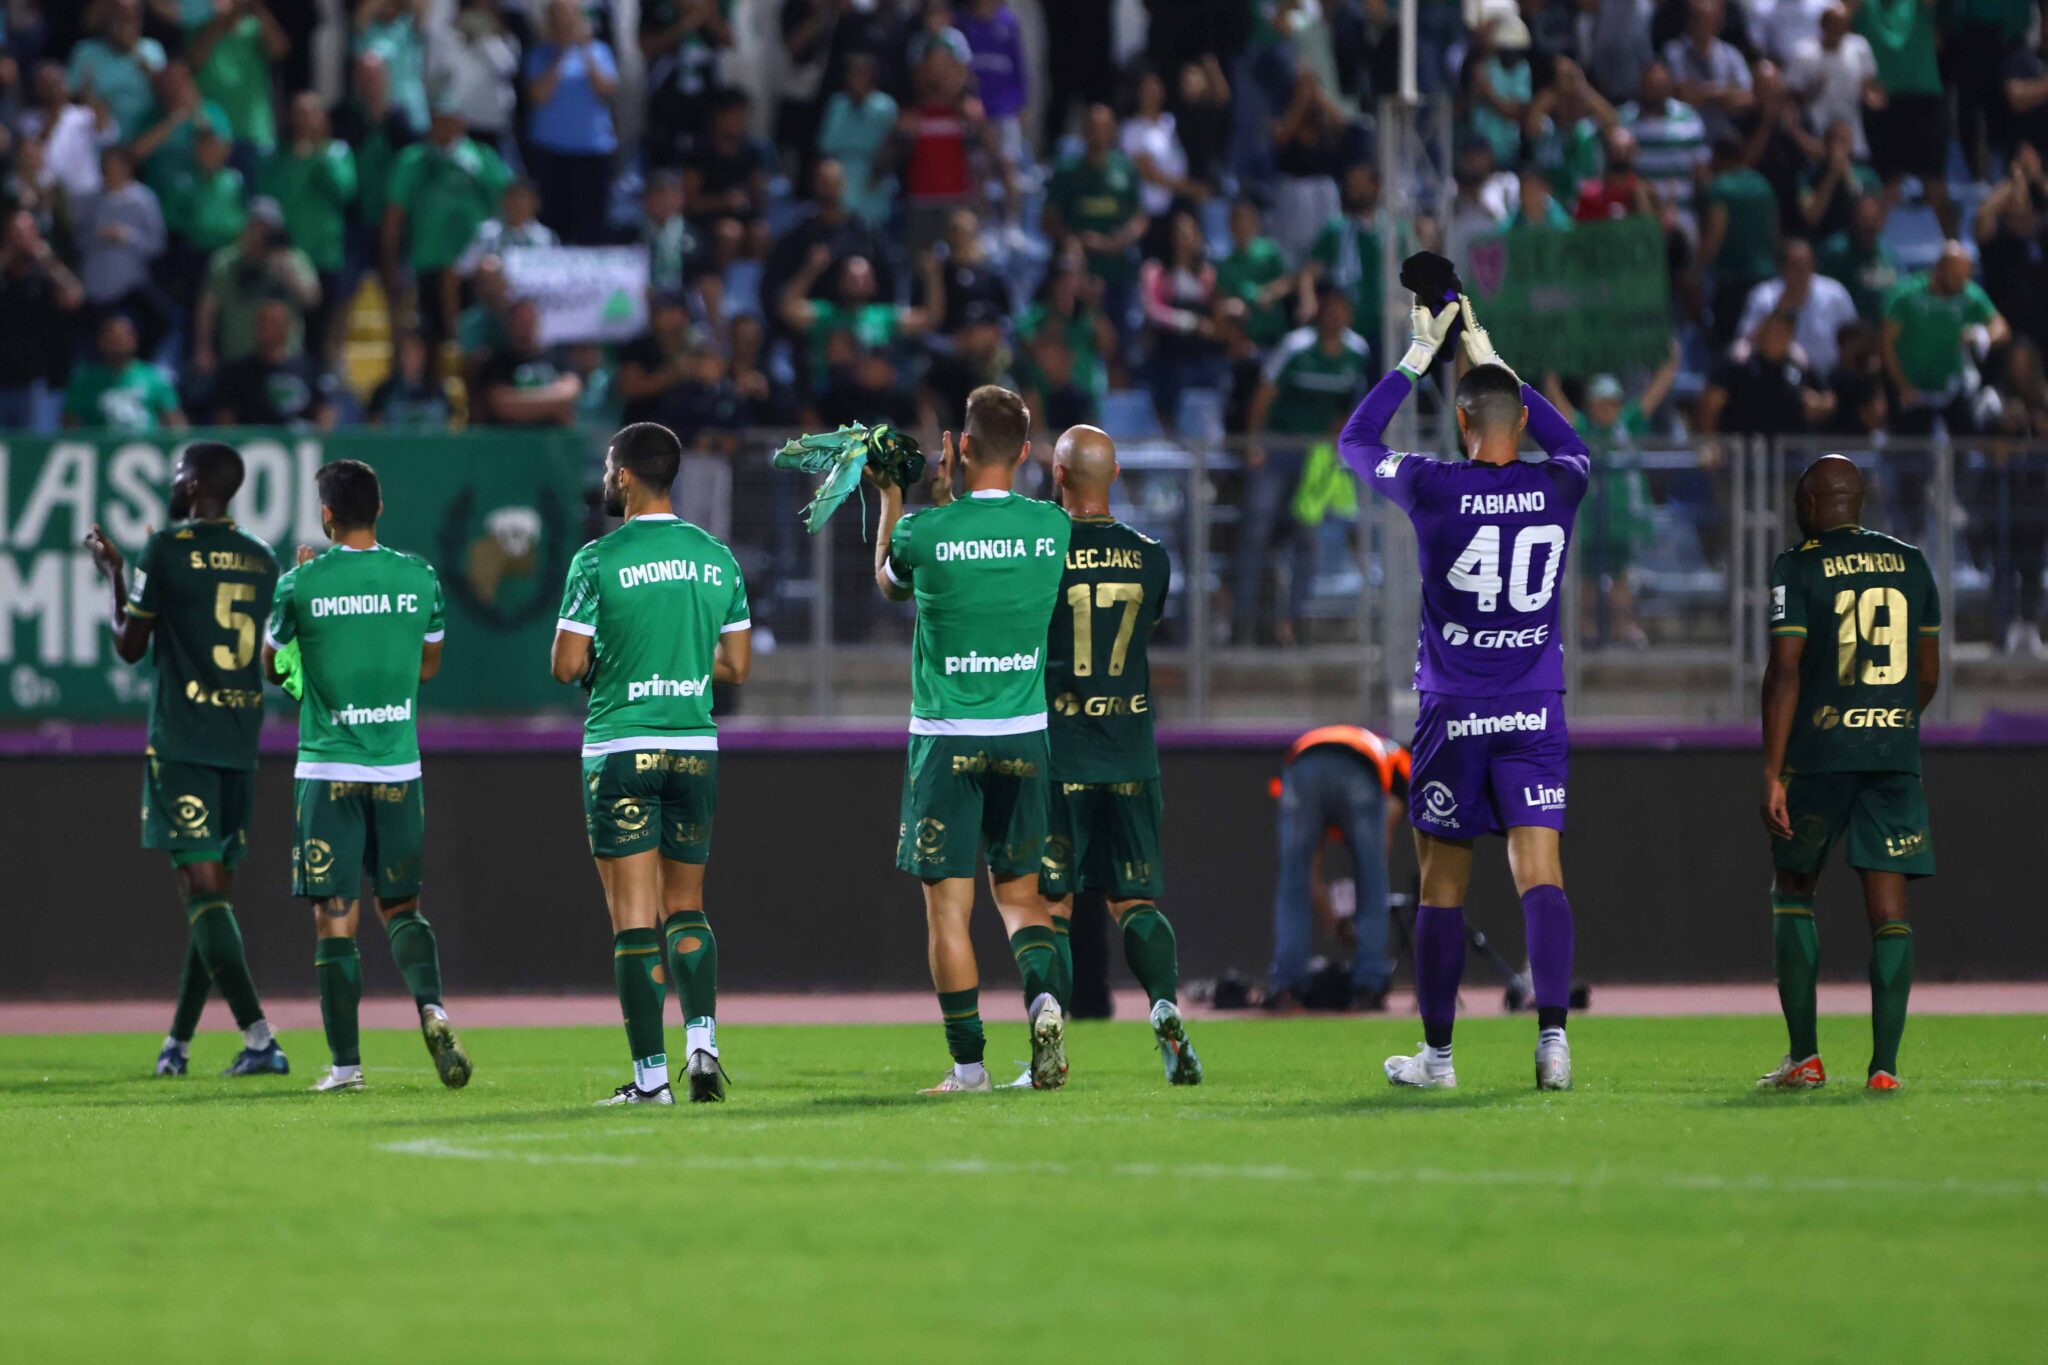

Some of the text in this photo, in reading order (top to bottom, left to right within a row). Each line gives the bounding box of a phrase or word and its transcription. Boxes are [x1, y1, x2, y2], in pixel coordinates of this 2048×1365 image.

[1460, 491, 1545, 514] FABIANO
[935, 537, 1056, 561] OMONOIA FC
[1065, 547, 1143, 570] LECJAKS
[618, 559, 722, 589] OMONOIA FC
[1446, 524, 1566, 612] 40
[1822, 552, 1906, 578] BACHIROU
[311, 593, 418, 617] OMONOIA FC
[212, 582, 257, 670] 5
[1067, 582, 1144, 678] 17
[1473, 624, 1549, 649] GREE
[1834, 586, 1908, 686] 19
[945, 646, 1040, 675] primetel
[1084, 694, 1148, 716] GRE
[1446, 706, 1547, 741] primetel
[1524, 784, 1566, 806] Line
